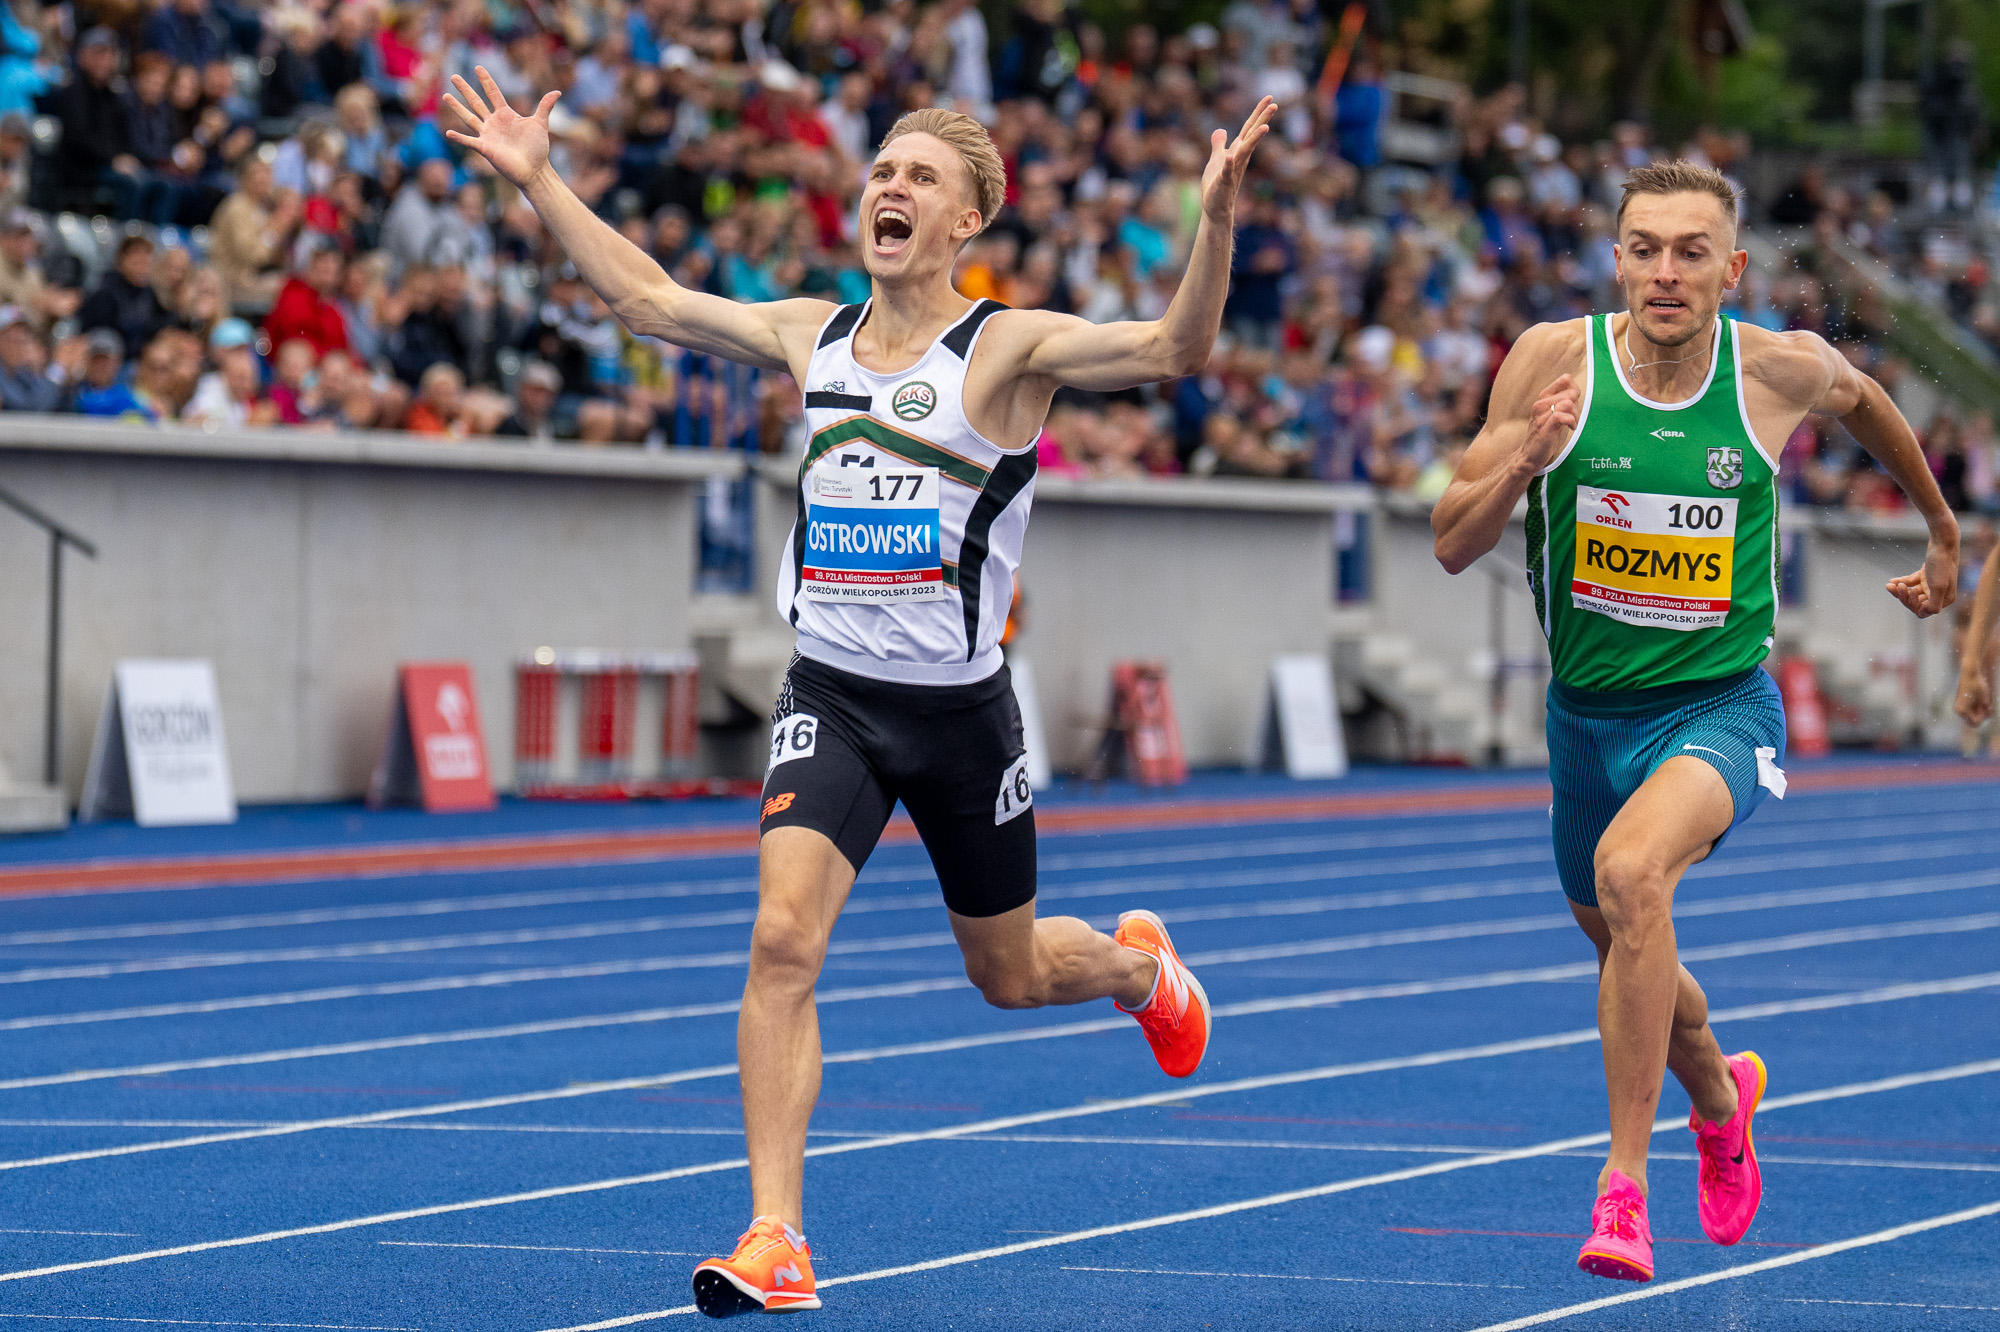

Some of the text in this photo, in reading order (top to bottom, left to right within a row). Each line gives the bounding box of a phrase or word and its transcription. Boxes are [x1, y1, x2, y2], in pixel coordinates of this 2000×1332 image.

[899, 387, 930, 402] RKS
[869, 475, 924, 500] 177
[1595, 515, 1632, 529] ORLEN
[1668, 503, 1723, 530] 100
[809, 520, 931, 555] OSTROWSKI
[1586, 538, 1722, 582] ROZMYS
[815, 571, 922, 583] 99. PZLA Mistrzostwa Polski
[807, 585, 936, 597] GORZÓW WIELKOPOLSKI 2023
[1591, 587, 1711, 610] 99. PZLA Mistrzostwa Polski
[1578, 598, 1720, 624] GORZÓW WIELKOPOLSKI 2023
[774, 720, 814, 758] 16
[1002, 766, 1030, 814] 16
